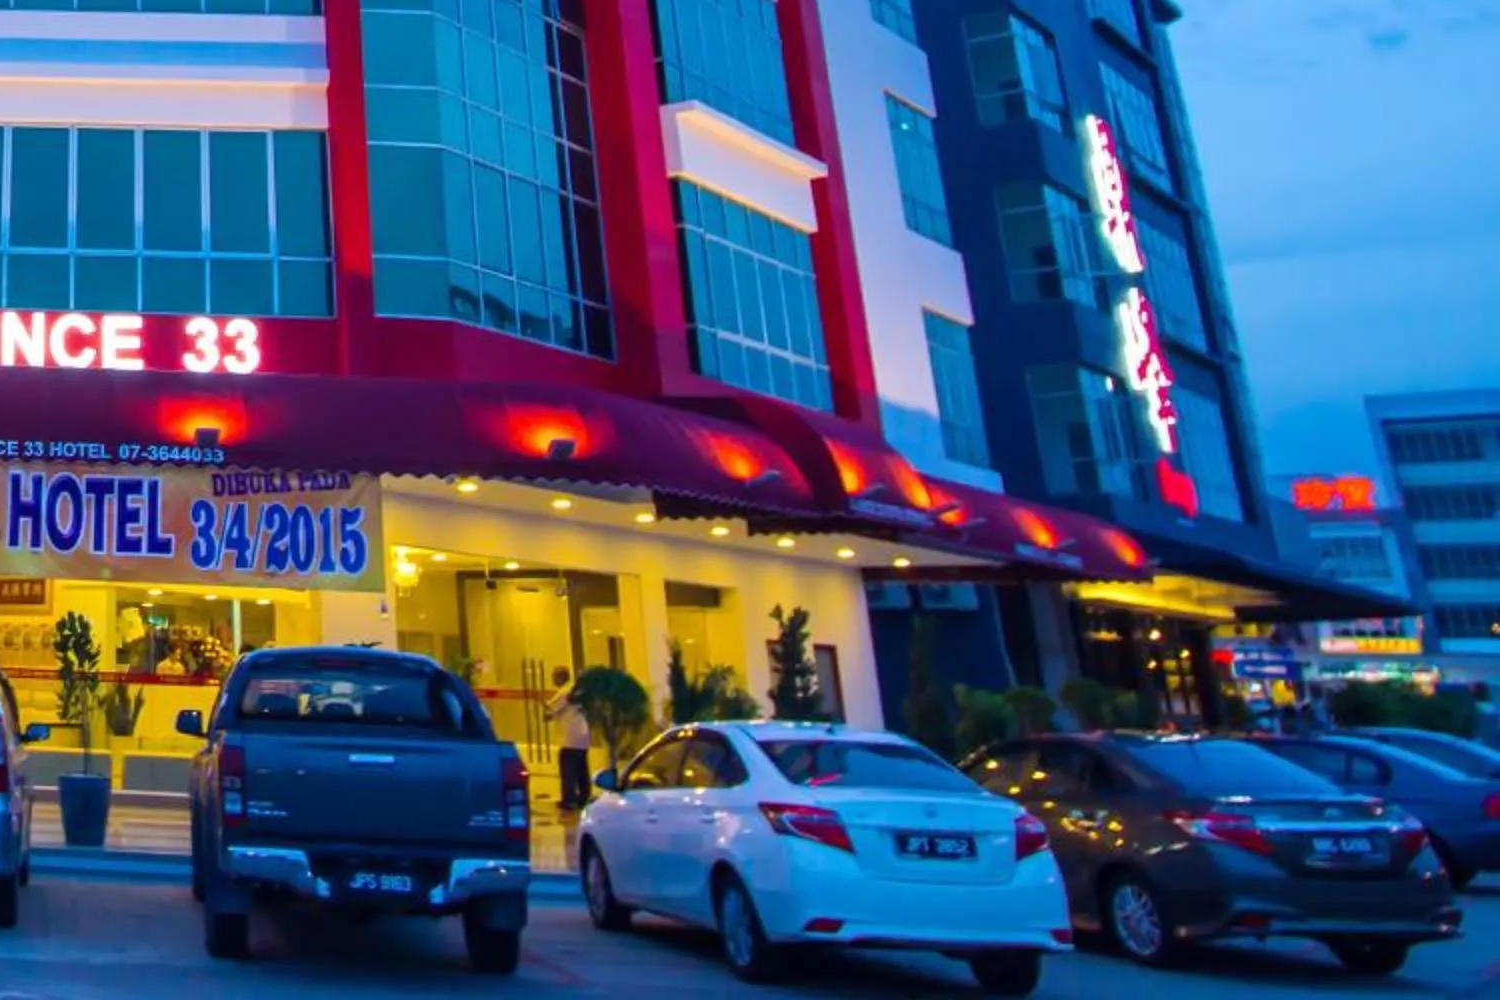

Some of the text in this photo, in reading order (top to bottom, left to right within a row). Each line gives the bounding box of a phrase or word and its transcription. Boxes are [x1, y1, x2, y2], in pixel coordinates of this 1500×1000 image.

[182, 314, 262, 375] 33
[23, 440, 44, 458] 33
[49, 442, 110, 460] HOTEL
[118, 444, 225, 463] 07-3644033
[7, 470, 175, 558] HOTEL
[211, 472, 291, 497] DIBUKA
[189, 497, 369, 577] 3/4/2015
